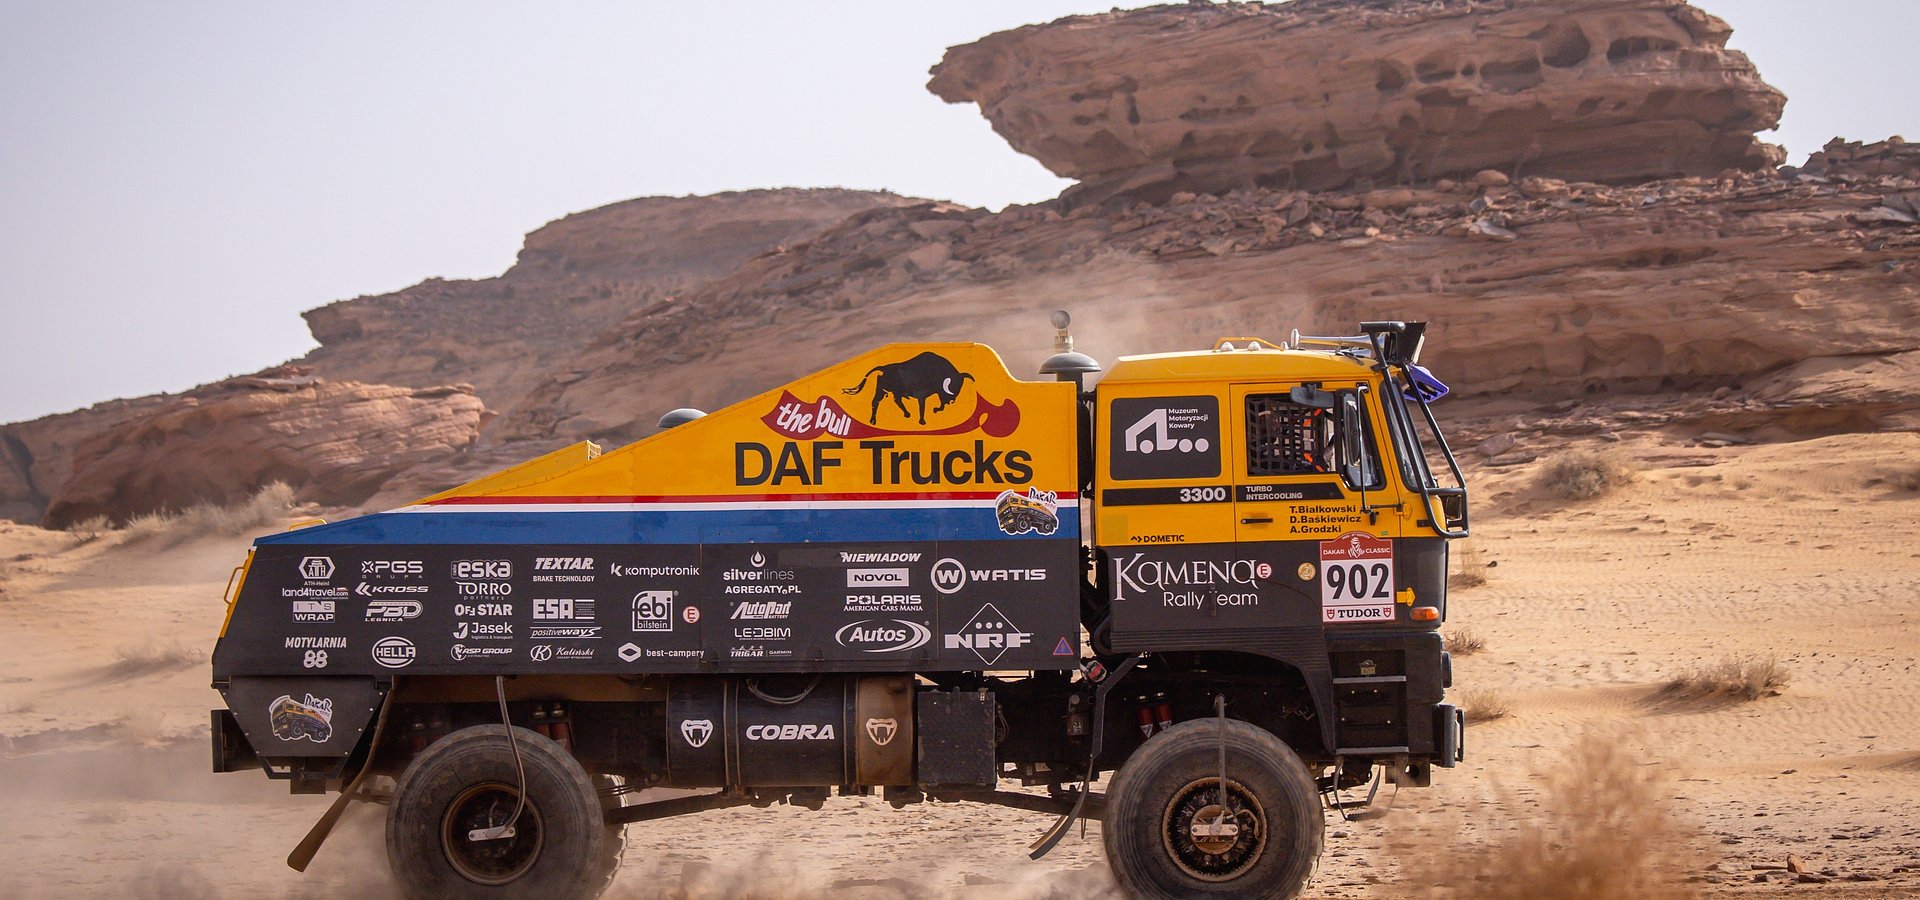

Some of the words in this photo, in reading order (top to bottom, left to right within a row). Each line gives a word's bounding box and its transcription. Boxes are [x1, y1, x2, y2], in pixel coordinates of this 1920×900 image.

[776, 402, 813, 433] the
[814, 399, 852, 436] bull
[1168, 414, 1209, 422] Motoryzacji
[735, 441, 844, 486] DAF
[860, 440, 1033, 485] Trucks
[1030, 487, 1056, 504] DAKAR
[1180, 487, 1226, 502] 3300
[1289, 505, 1356, 514] T.Białkowski
[1289, 515, 1361, 524] D.Baśkiewicz
[1289, 525, 1341, 534] A.Grodzki
[457, 561, 512, 578] eska
[625, 565, 700, 578] komputronik
[970, 569, 1046, 581] WATIS
[854, 574, 902, 582] NOVOL
[1326, 563, 1390, 600] 902
[455, 581, 512, 595] TORRO
[846, 595, 922, 605] POLARIS
[1163, 592, 1204, 610] Rally
[1209, 591, 1258, 606] eam
[295, 603, 332, 611] ITS
[533, 599, 574, 619] ESA
[1338, 609, 1381, 618] TUDOR
[471, 622, 513, 634] Jasek
[637, 621, 668, 629] bilstein
[734, 628, 791, 638] LEDBIM
[849, 627, 906, 642] Autos
[285, 637, 347, 649] MOTYLARNIA
[944, 633, 1030, 649] NRF
[375, 646, 416, 658] HELLA
[646, 650, 705, 659] best-campery
[303, 650, 328, 669] 88
[305, 695, 330, 711] DAKAR
[746, 724, 835, 740] COBRA
